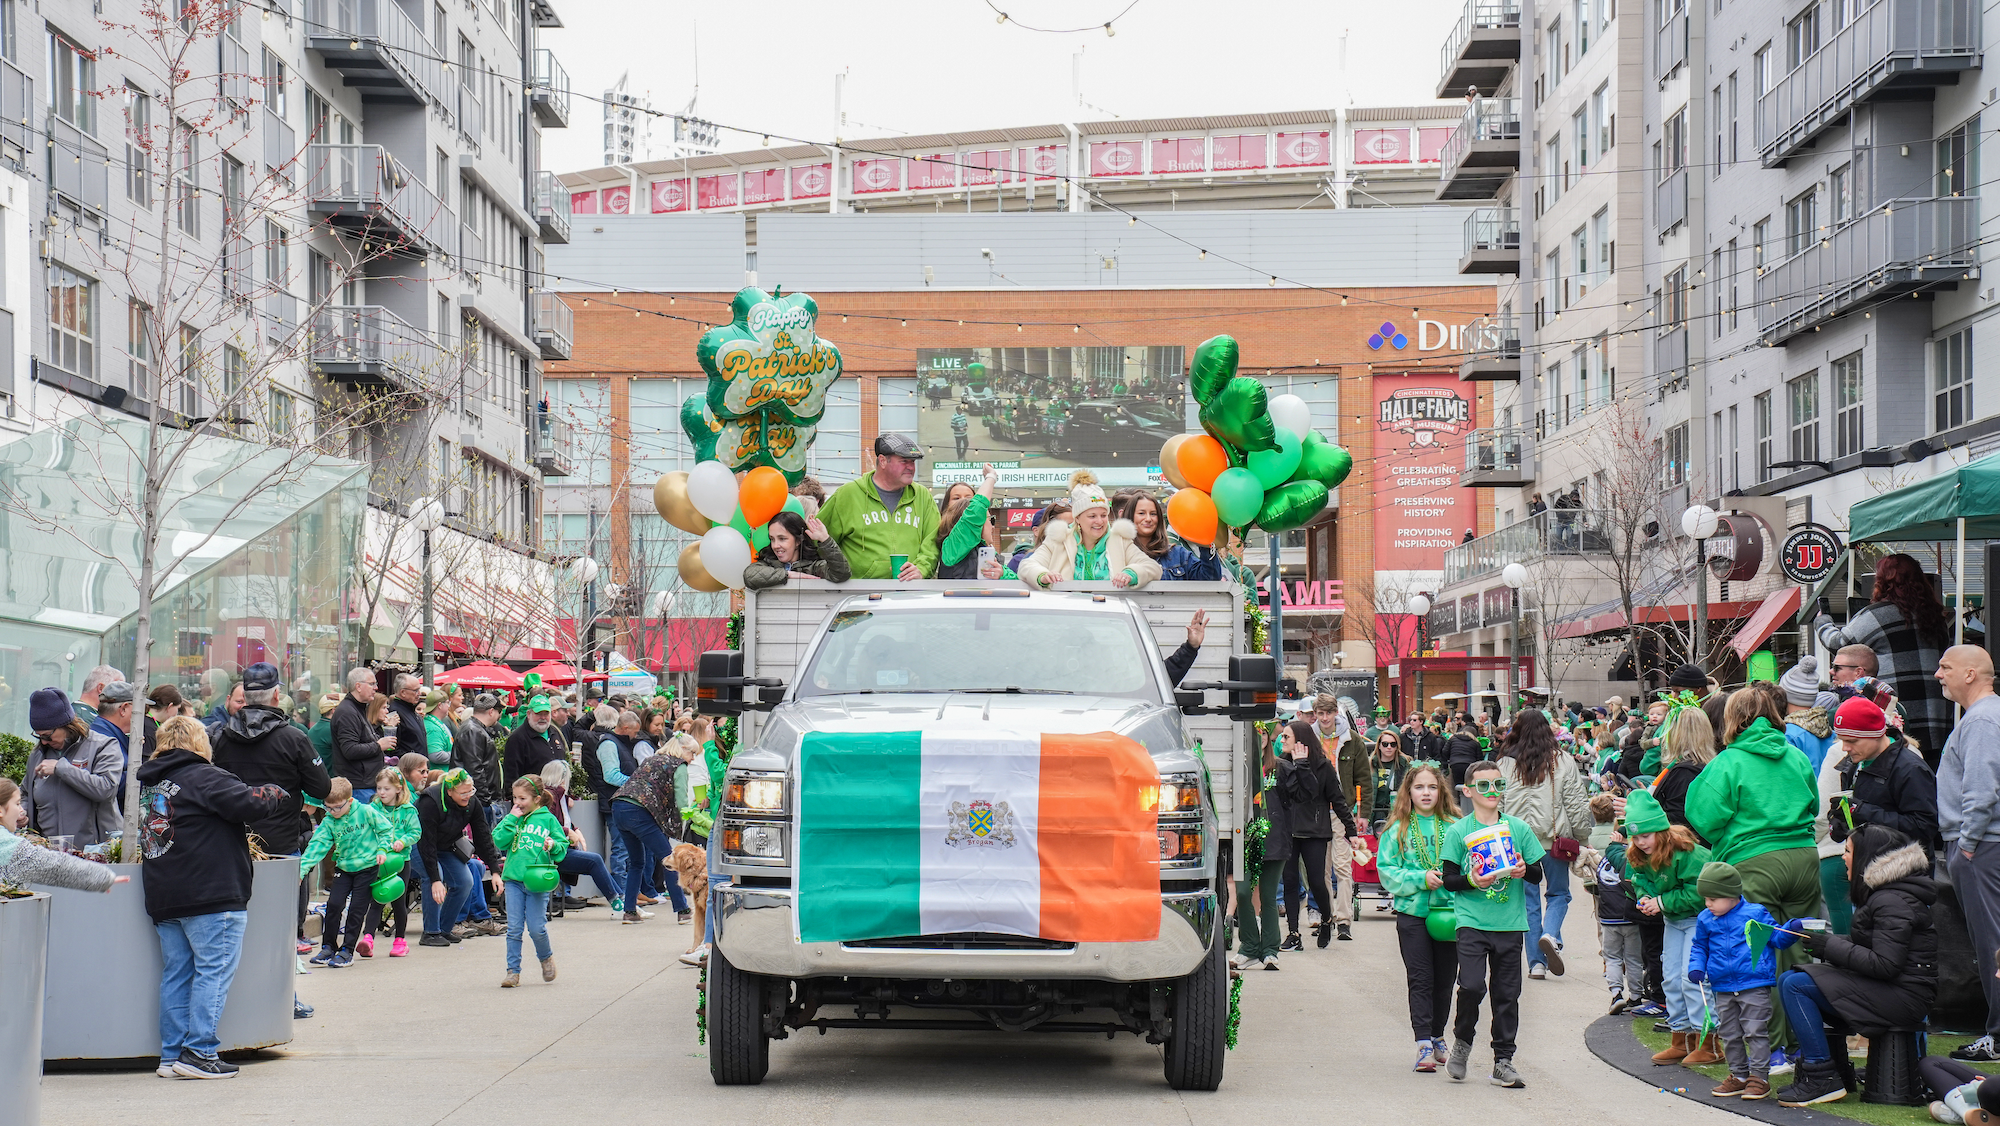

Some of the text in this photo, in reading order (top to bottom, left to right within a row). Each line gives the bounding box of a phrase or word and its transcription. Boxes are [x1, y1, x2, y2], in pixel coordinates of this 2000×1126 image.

[1295, 145, 1320, 154] REDS
[1375, 142, 1400, 151] REDS
[1109, 154, 1133, 163] REDS
[1168, 158, 1248, 172] Budweiser
[869, 171, 892, 180] REDS
[805, 176, 826, 186] REDS
[665, 191, 684, 201] REDS
[613, 198, 629, 207] REDS
[752, 309, 812, 332] Happy
[774, 331, 794, 350] St.
[721, 343, 837, 381] Patrick's
[933, 358, 962, 369] LIVE
[745, 377, 813, 406] Day
[1381, 397, 1468, 422] HALL OF FAME
[1394, 420, 1455, 432] AND MUSEUM
[736, 425, 797, 458] Day
[1391, 466, 1457, 475] CELEBRATING
[936, 473, 1071, 483] CELEBRAT IRISH HERITAGE
[1397, 478, 1452, 487] GREATNESS
[1394, 497, 1455, 506] PRESERVING
[1404, 508, 1446, 517] HISTORY
[862, 510, 920, 528] BROGAN
[1397, 528, 1453, 537] PROVIDING
[1394, 539, 1456, 548] INSPIRATION
[1786, 533, 1833, 554] JIMMY JOHN'S
[1797, 545, 1823, 569] JJ
[1790, 567, 1830, 580] SANDWICHES
[966, 839, 994, 847] Brogan
